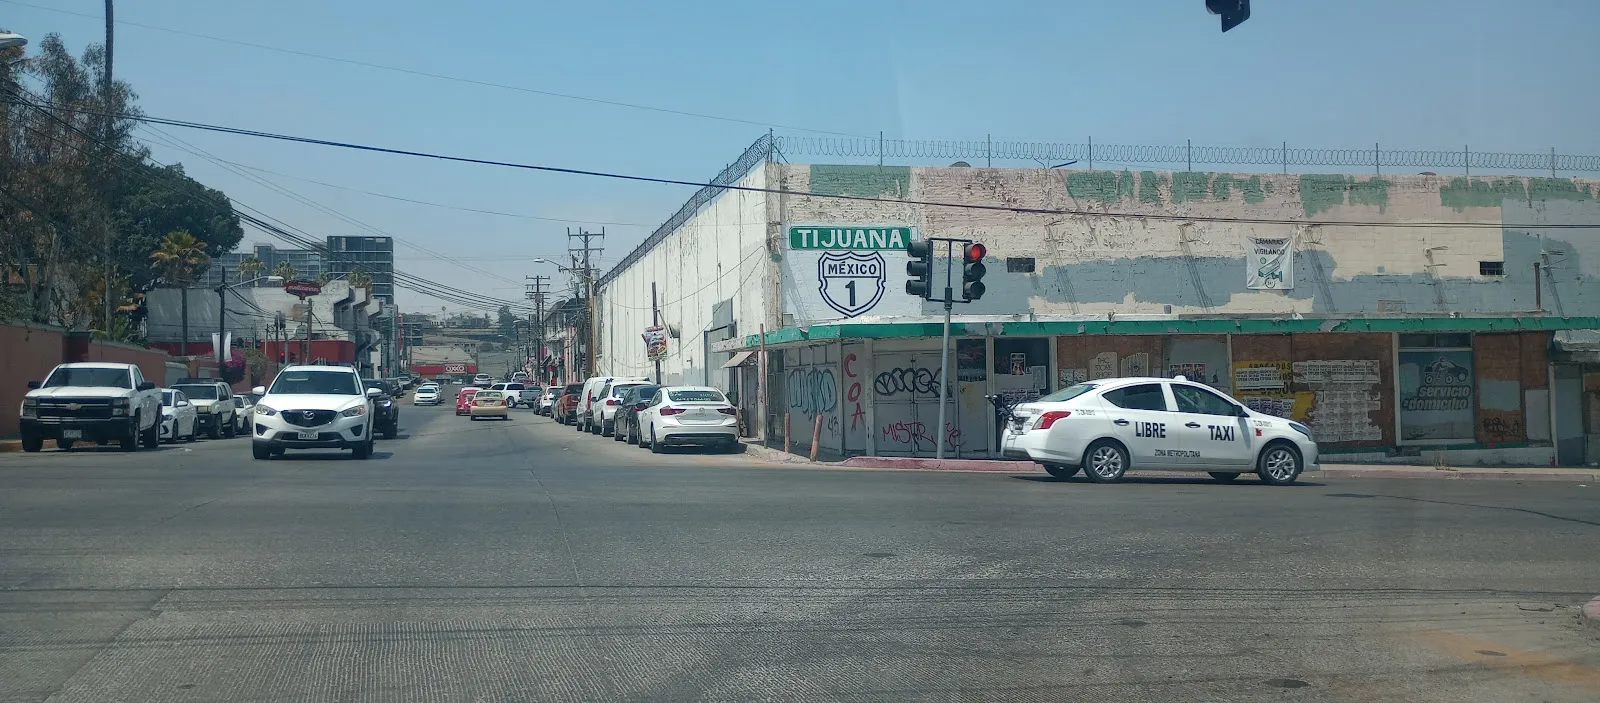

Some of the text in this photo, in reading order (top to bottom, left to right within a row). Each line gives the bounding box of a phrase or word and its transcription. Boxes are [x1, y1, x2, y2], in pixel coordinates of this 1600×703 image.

[797, 229, 904, 249] TIJUANA
[828, 261, 877, 275] MÉXICO
[845, 280, 856, 307] 1
[1418, 386, 1471, 397] servicio
[1409, 398, 1468, 410] domicilio
[1135, 421, 1235, 442] LIBRE TAXI
[1167, 449, 1201, 458] METROPOLITANA
